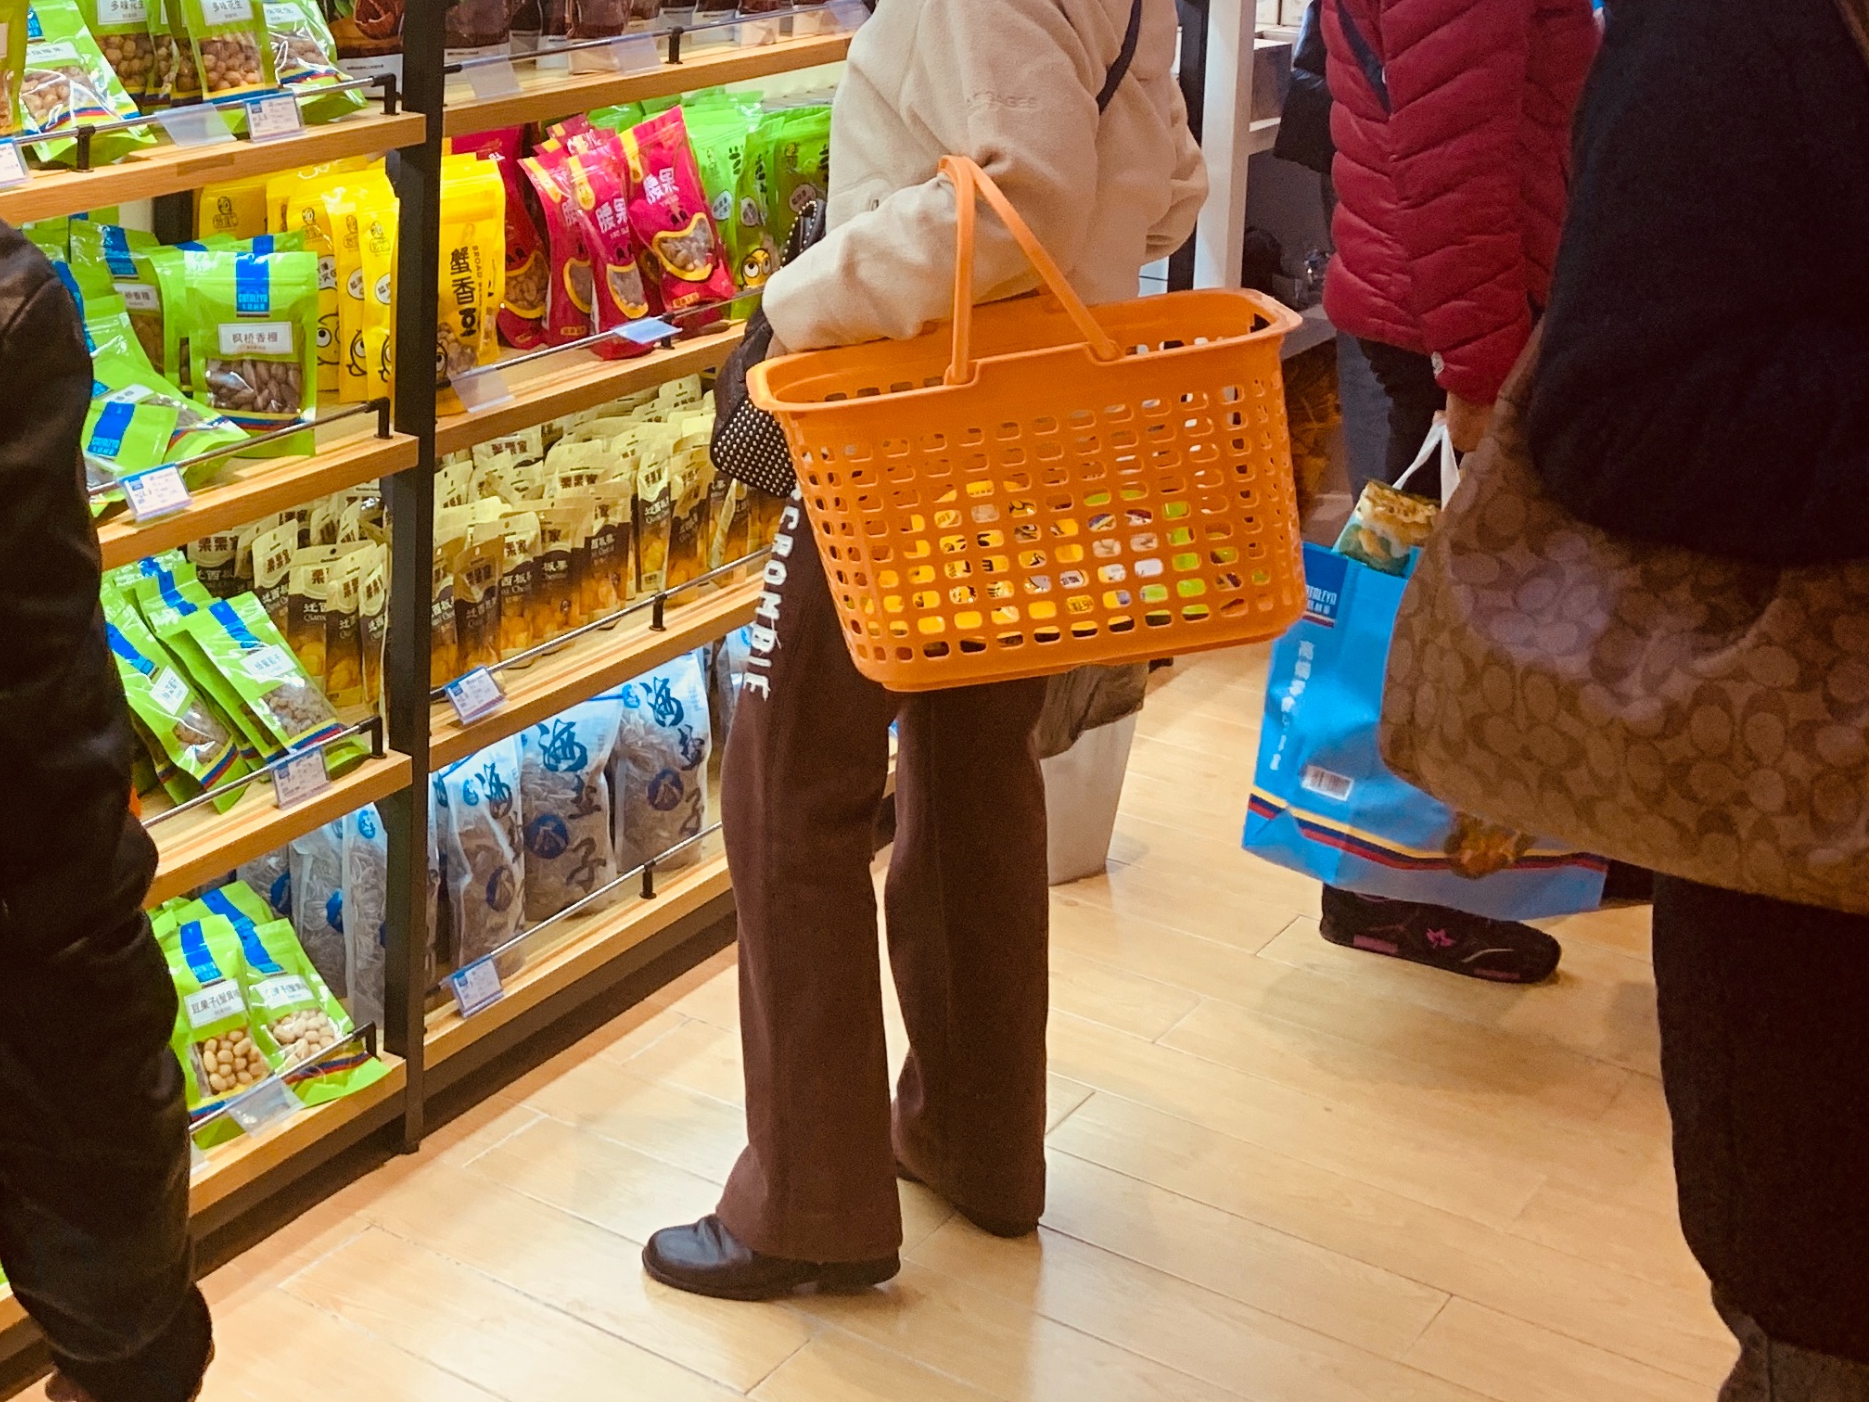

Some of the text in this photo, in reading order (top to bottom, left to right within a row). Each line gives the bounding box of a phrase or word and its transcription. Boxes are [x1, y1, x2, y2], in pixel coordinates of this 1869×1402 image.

[595, 197, 629, 234] 腰果
[643, 166, 680, 205] 腰果
[449, 248, 478, 338] 蟹香豆
[741, 505, 800, 702] CROMBIE
